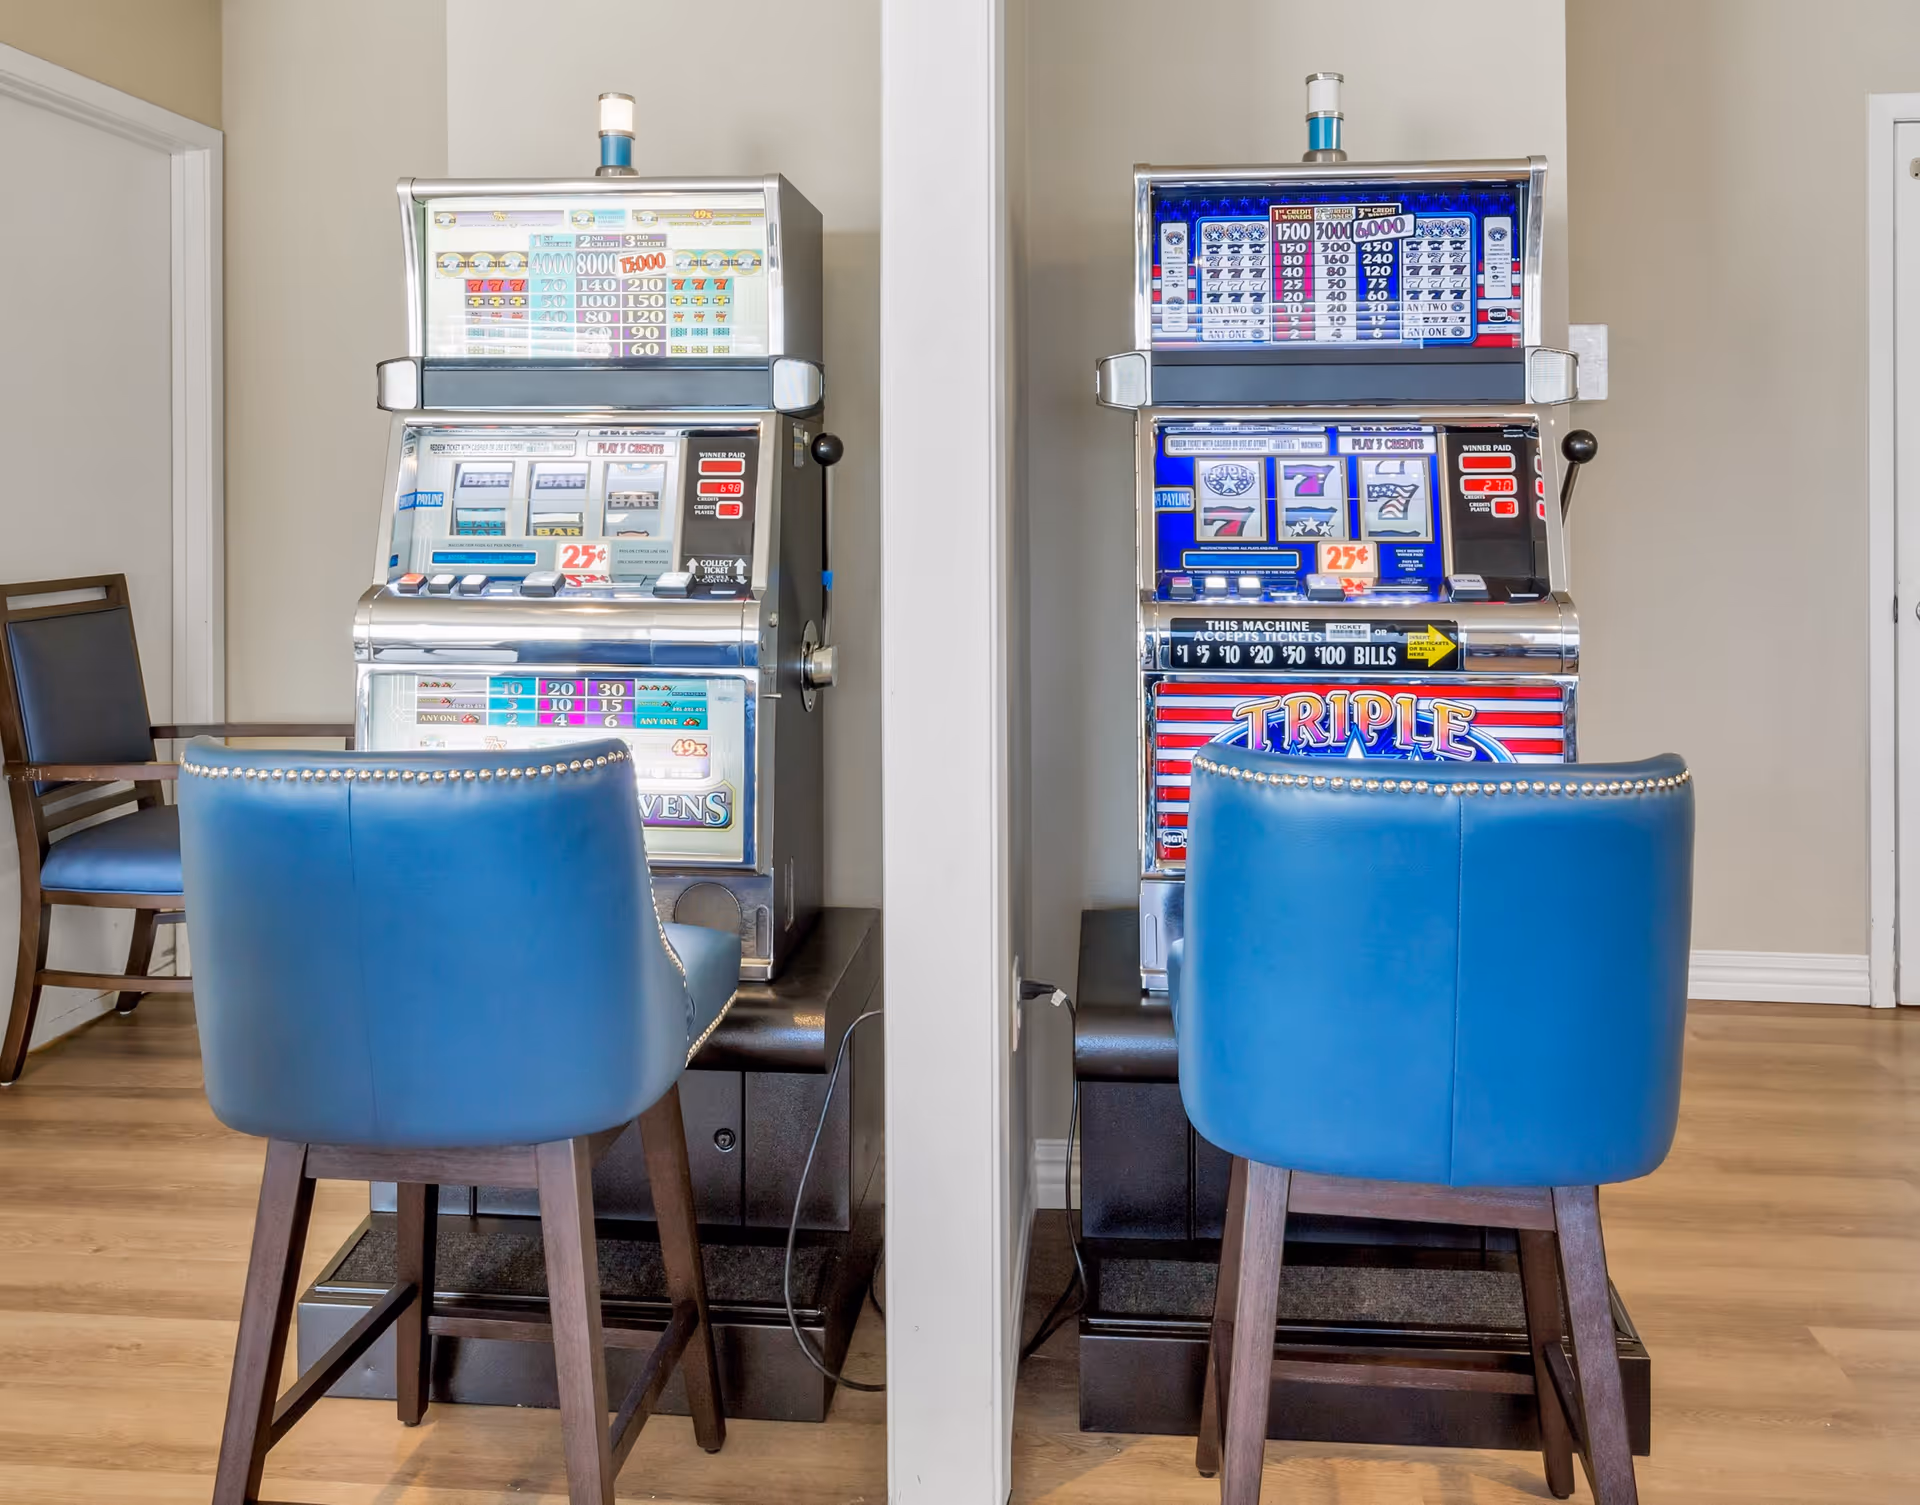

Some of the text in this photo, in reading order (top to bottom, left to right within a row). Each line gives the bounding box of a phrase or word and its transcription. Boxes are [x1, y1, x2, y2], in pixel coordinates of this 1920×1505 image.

[1276, 222, 1311, 240] 1500
[1316, 222, 1352, 240] 3000
[1280, 243, 1306, 254] 150
[1320, 242, 1351, 252] 300
[1362, 242, 1393, 252] 450
[1282, 255, 1304, 266] 80
[1322, 254, 1350, 264] 160
[1362, 254, 1394, 264] 240
[1282, 268, 1304, 278] 40
[1326, 266, 1346, 276] 80
[1364, 266, 1392, 276] 120
[580, 279, 616, 292] 140
[628, 278, 662, 292] 210
[1284, 280, 1302, 290] 25
[1328, 279, 1346, 289] 50
[1368, 278, 1388, 289] 75
[580, 294, 616, 307] 100
[626, 294, 664, 308] 150
[1284, 292, 1304, 302] 20
[1326, 291, 1347, 301] 40
[1368, 290, 1388, 300] 60
[1206, 306, 1247, 314] ANY TWO
[1327, 304, 1347, 313] 20
[1406, 303, 1448, 312] ANY TWO
[585, 310, 612, 323] 80
[626, 310, 664, 323] 120
[1328, 316, 1346, 326] 10
[630, 326, 660, 340] 90
[1228, 330, 1247, 338] ONE
[1428, 328, 1447, 336] ONE
[630, 342, 660, 356] 60
[598, 443, 618, 454] PLAY
[628, 443, 664, 454] CREDITS
[1352, 438, 1373, 450] PLAY
[1385, 438, 1424, 450] CREDITS
[1162, 492, 1190, 506] PAYLINE
[536, 528, 581, 536] BAR
[562, 545, 606, 569] 25¢
[1326, 546, 1369, 570] 25¢
[1206, 620, 1310, 632] THIS MACHINE
[1194, 630, 1322, 642] ACCEPTS TICKETS
[1176, 644, 1398, 666] $1 $5 $10 $20 $50 $100 BILLS
[502, 682, 523, 696] 10
[548, 683, 575, 696] 20
[598, 683, 625, 696] 30
[507, 698, 518, 711] 5
[550, 698, 572, 712] 10
[600, 699, 622, 712] 15
[506, 713, 518, 726] 2
[554, 713, 568, 727] 4
[604, 714, 618, 728] 6
[640, 718, 678, 726] ANY ONE
[1232, 690, 1478, 763] TRIPLE
[672, 738, 708, 757] 49x
